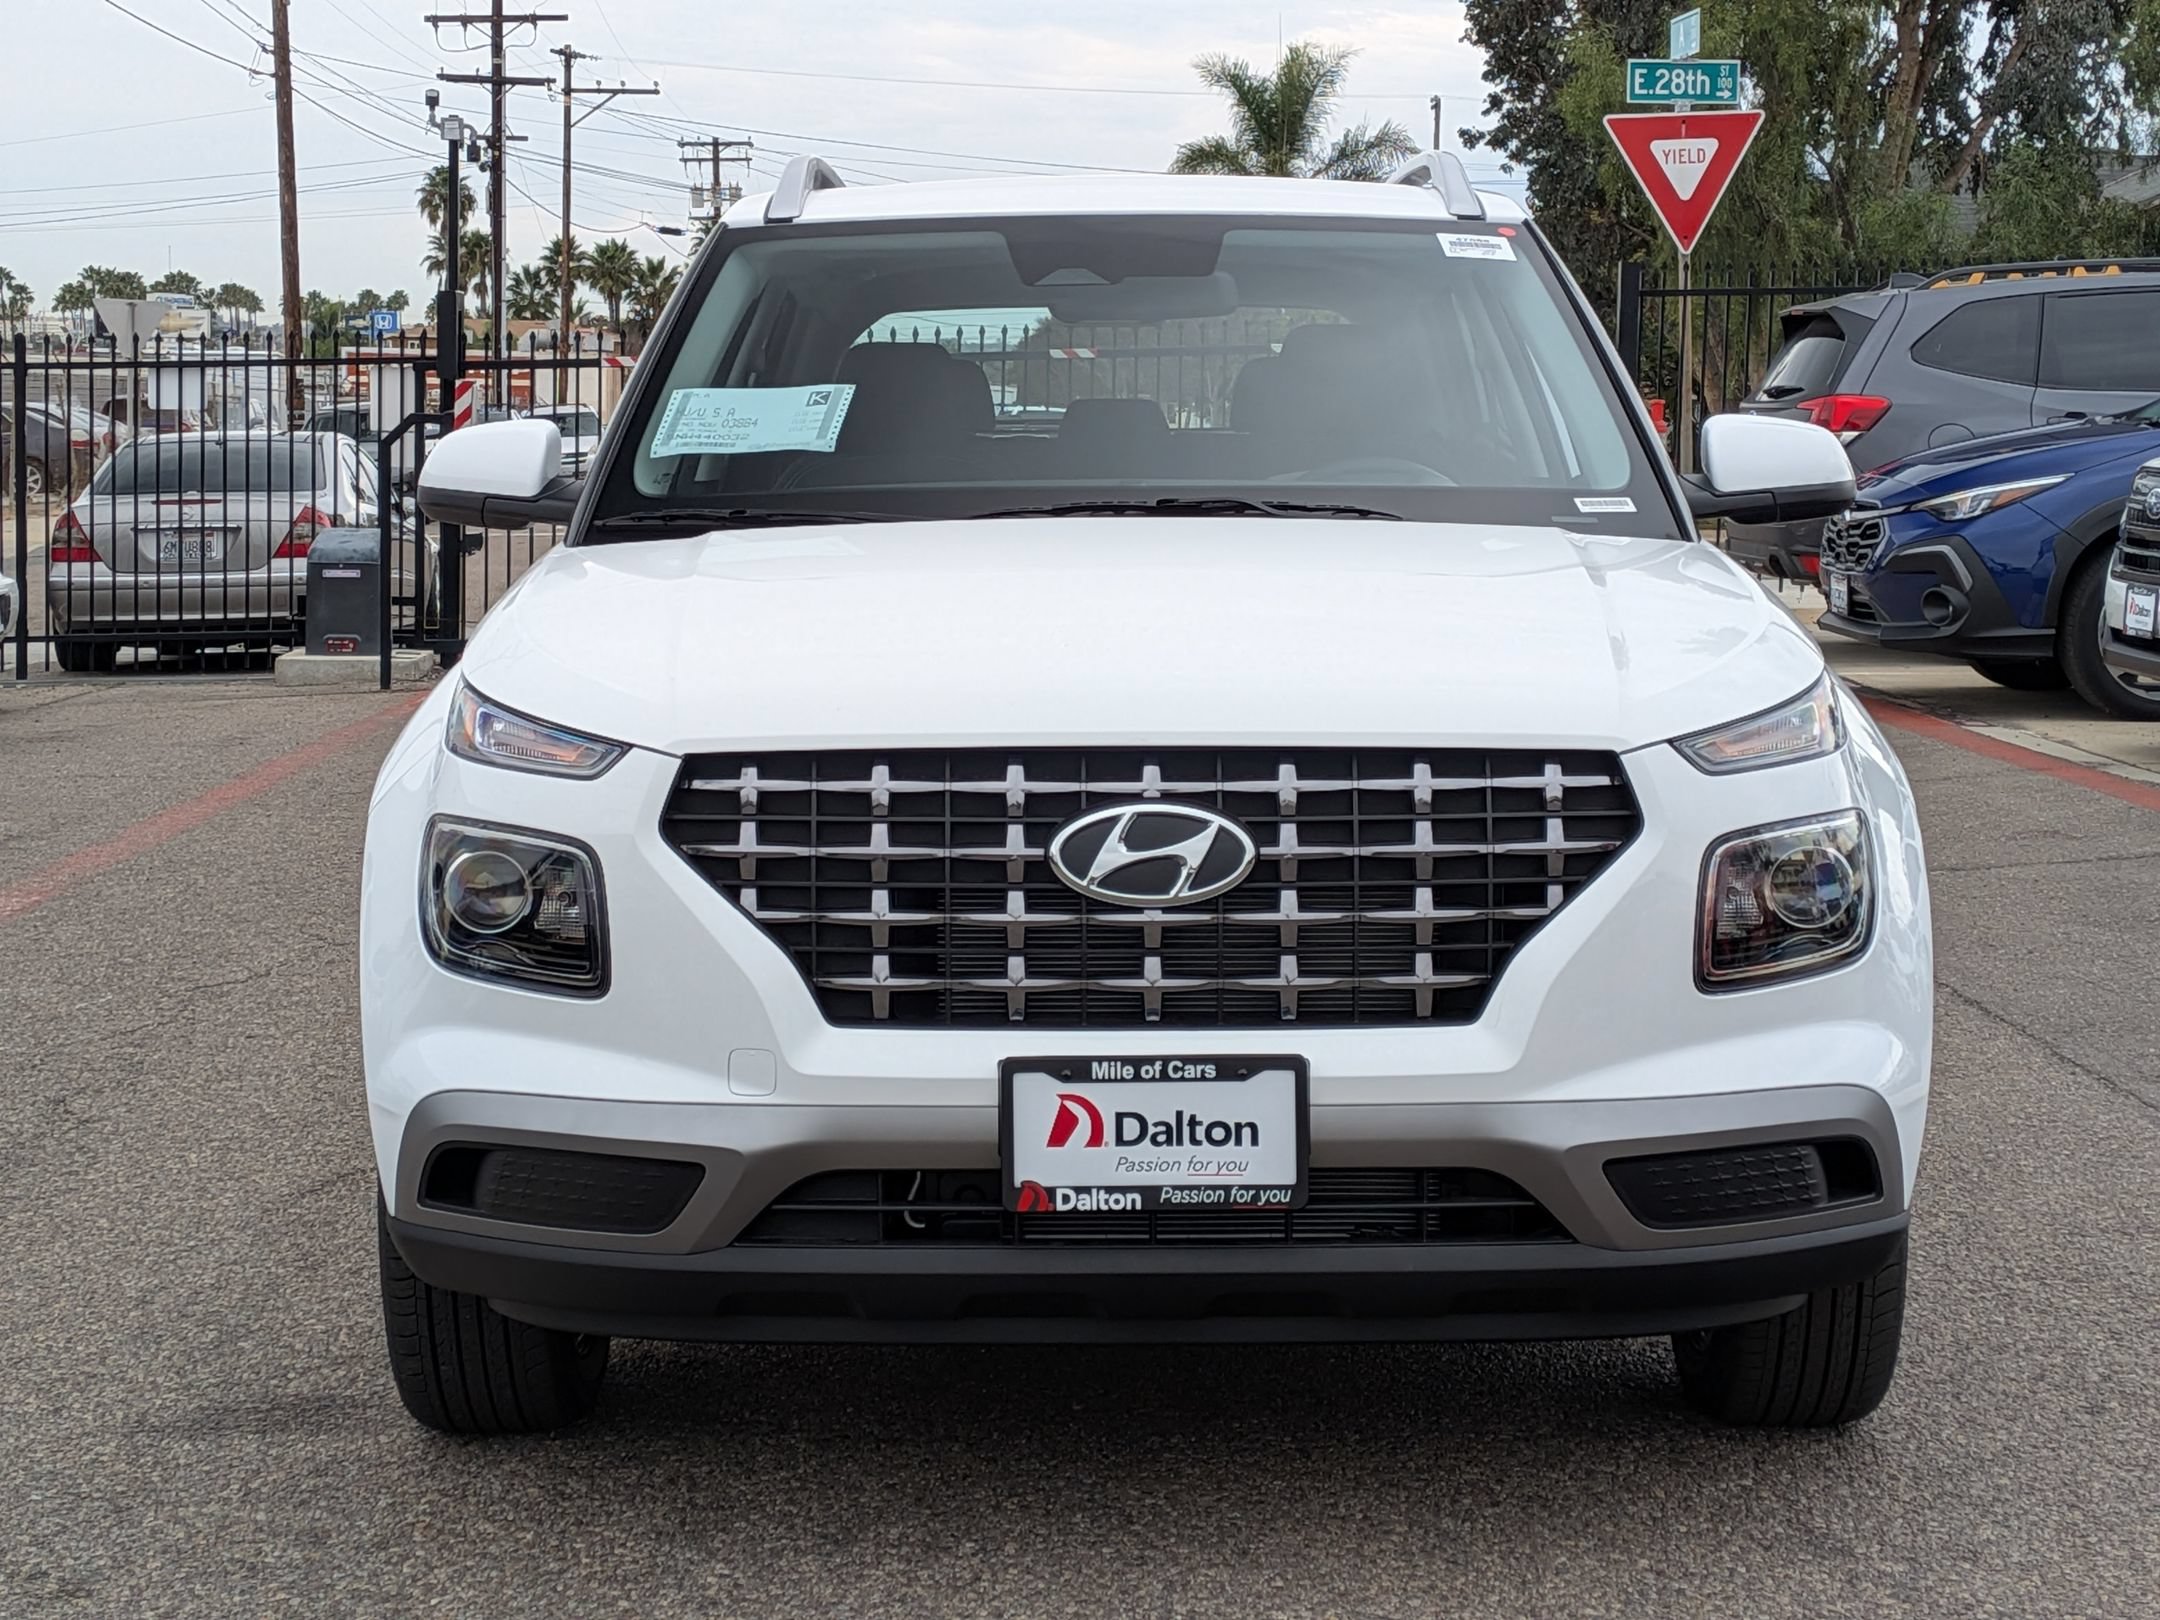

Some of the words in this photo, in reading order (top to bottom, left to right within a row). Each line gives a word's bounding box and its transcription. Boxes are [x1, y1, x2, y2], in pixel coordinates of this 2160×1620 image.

[1634, 68, 1710, 95] E.28th
[1717, 77, 1733, 89] 100
[1662, 148, 1706, 165] YIELD
[1091, 1061, 1133, 1080] Mile
[1140, 1061, 1163, 1079] of
[1167, 1061, 1216, 1079] Cars
[1115, 1110, 1259, 1147] Dalton
[1115, 1156, 1181, 1173] Passion
[1187, 1155, 1213, 1173] for
[1215, 1159, 1249, 1174] you
[1055, 1188, 1142, 1212] Dalton
[1160, 1187, 1227, 1204] Passion
[1229, 1186, 1255, 1204] for
[1256, 1188, 1291, 1206] you
